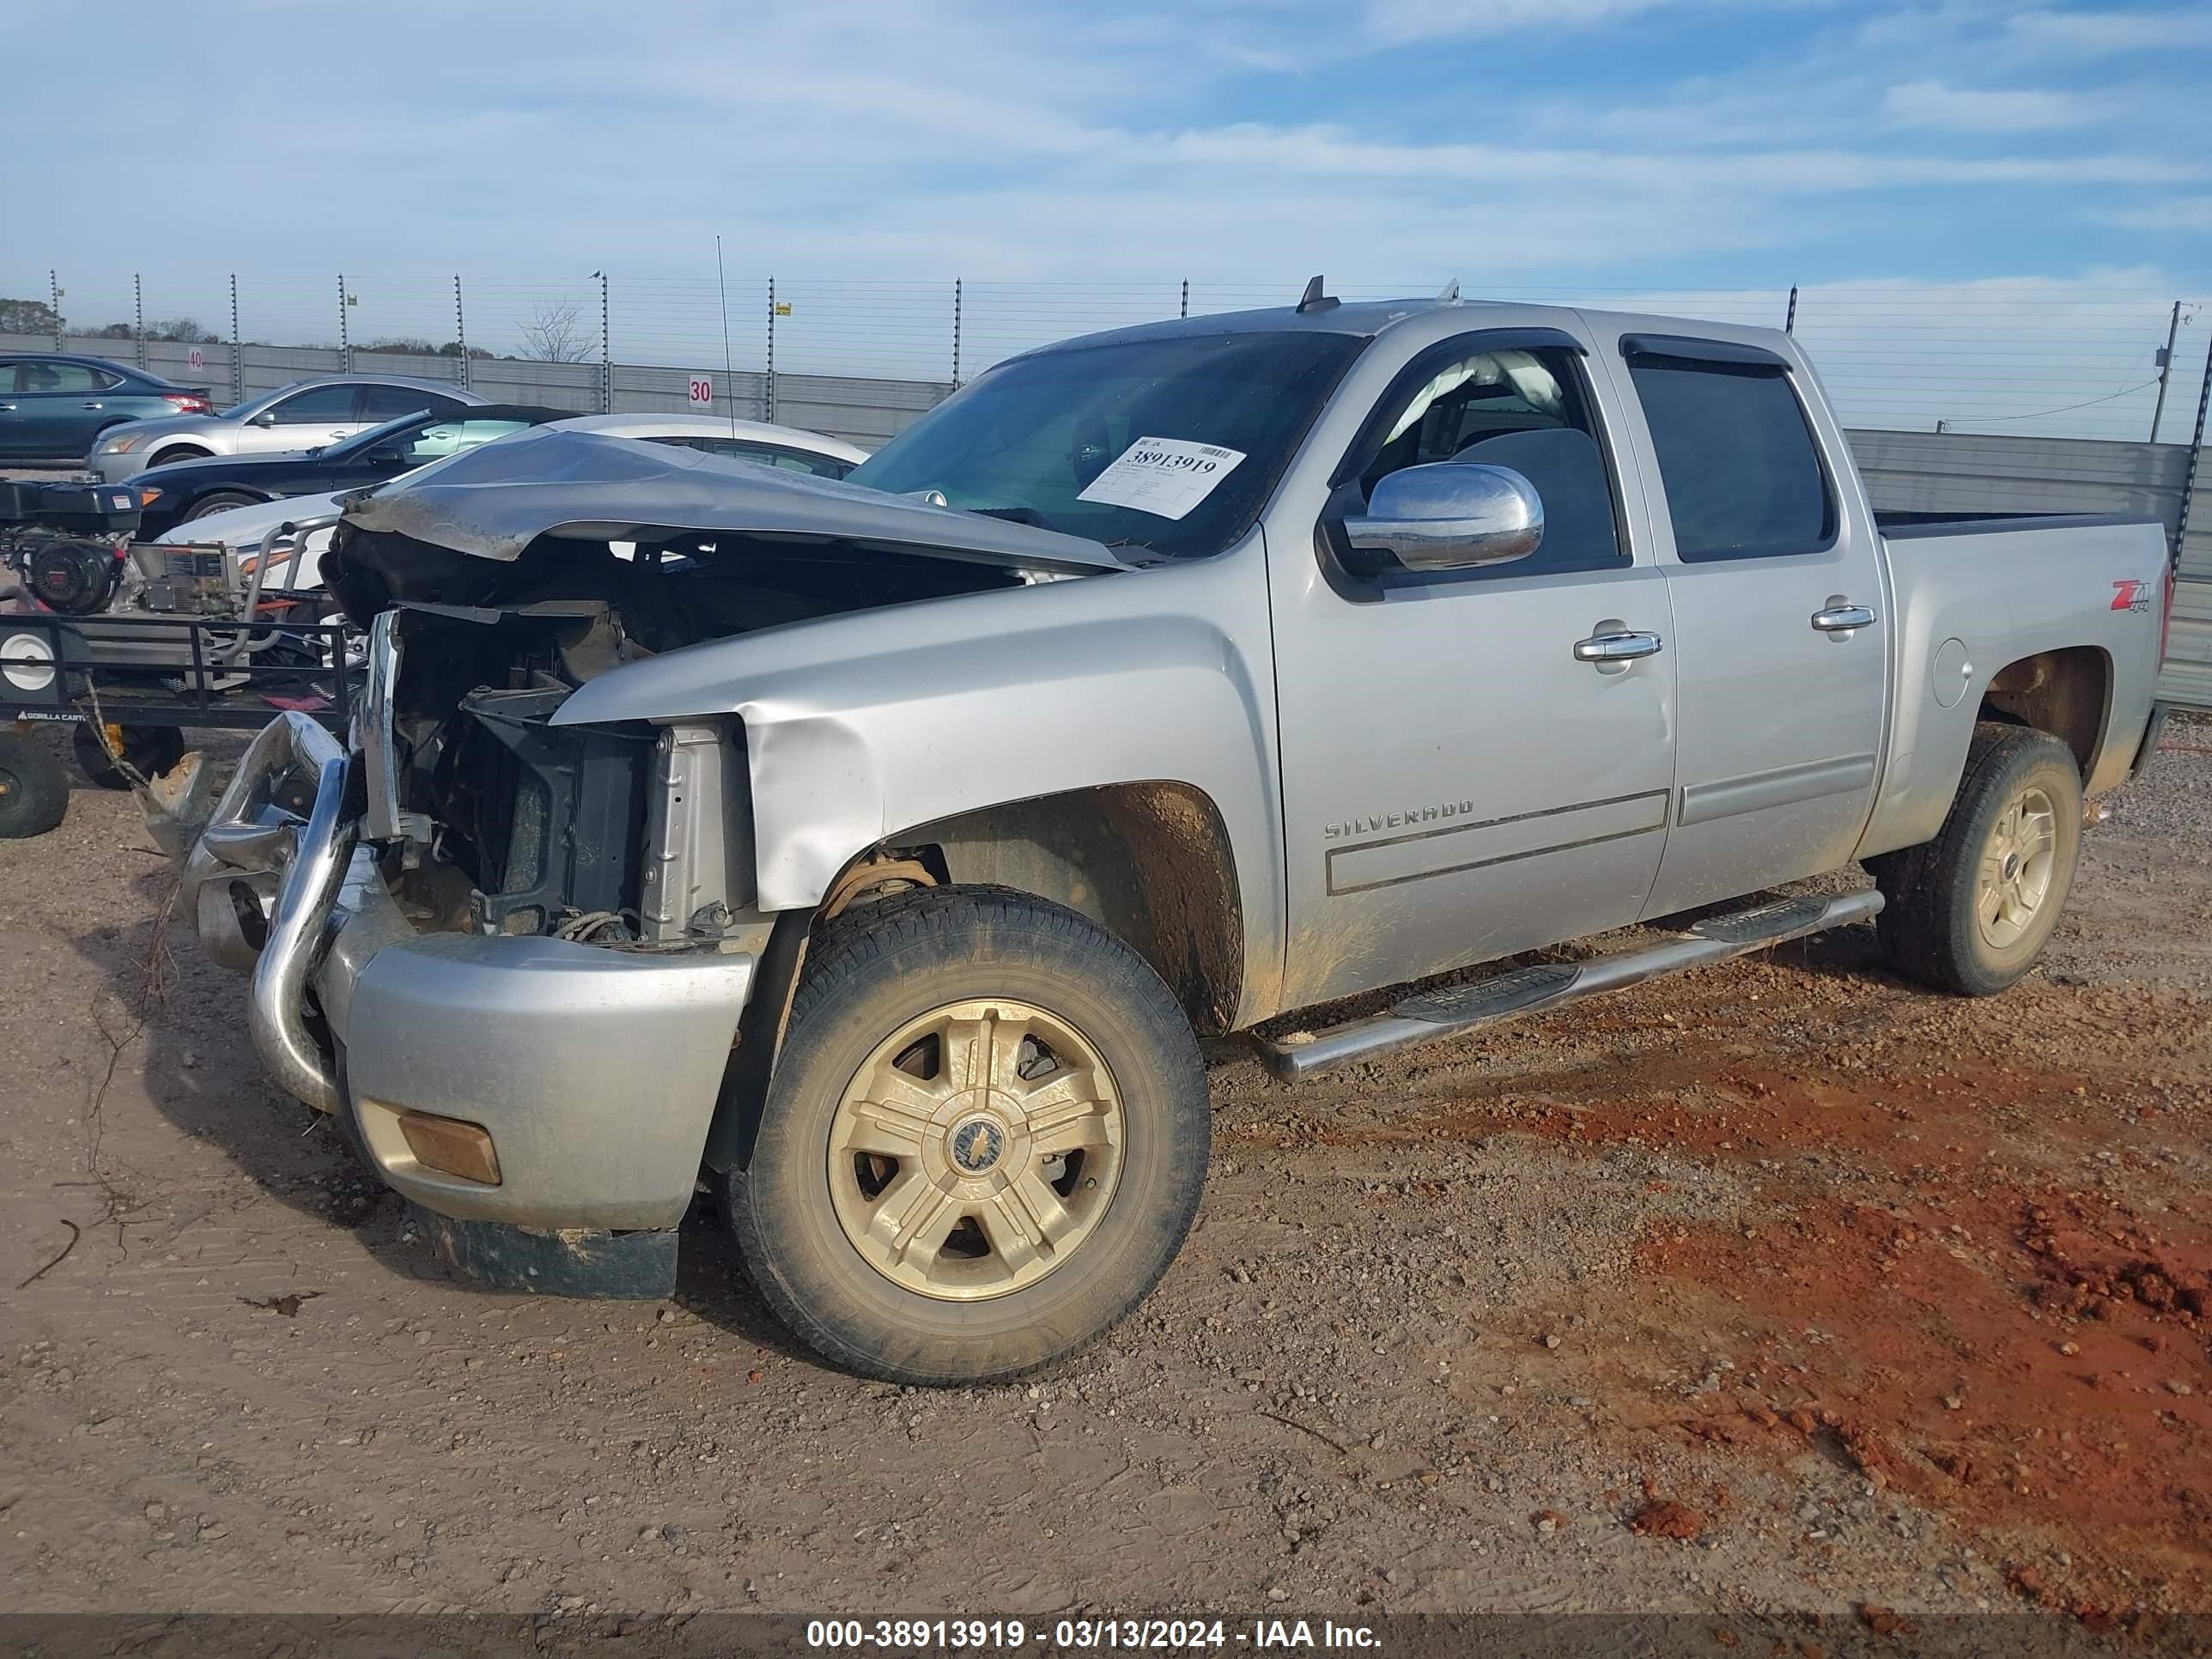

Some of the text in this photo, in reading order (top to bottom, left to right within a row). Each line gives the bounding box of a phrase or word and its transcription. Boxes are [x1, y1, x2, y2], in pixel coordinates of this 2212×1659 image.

[190, 351, 202, 368] 40
[690, 380, 711, 402] 30
[1126, 450, 1218, 474] 38913919
[2110, 579, 2151, 611] Z71
[27, 712, 60, 720] GORILLA
[1324, 798, 1474, 840] SILVERADO
